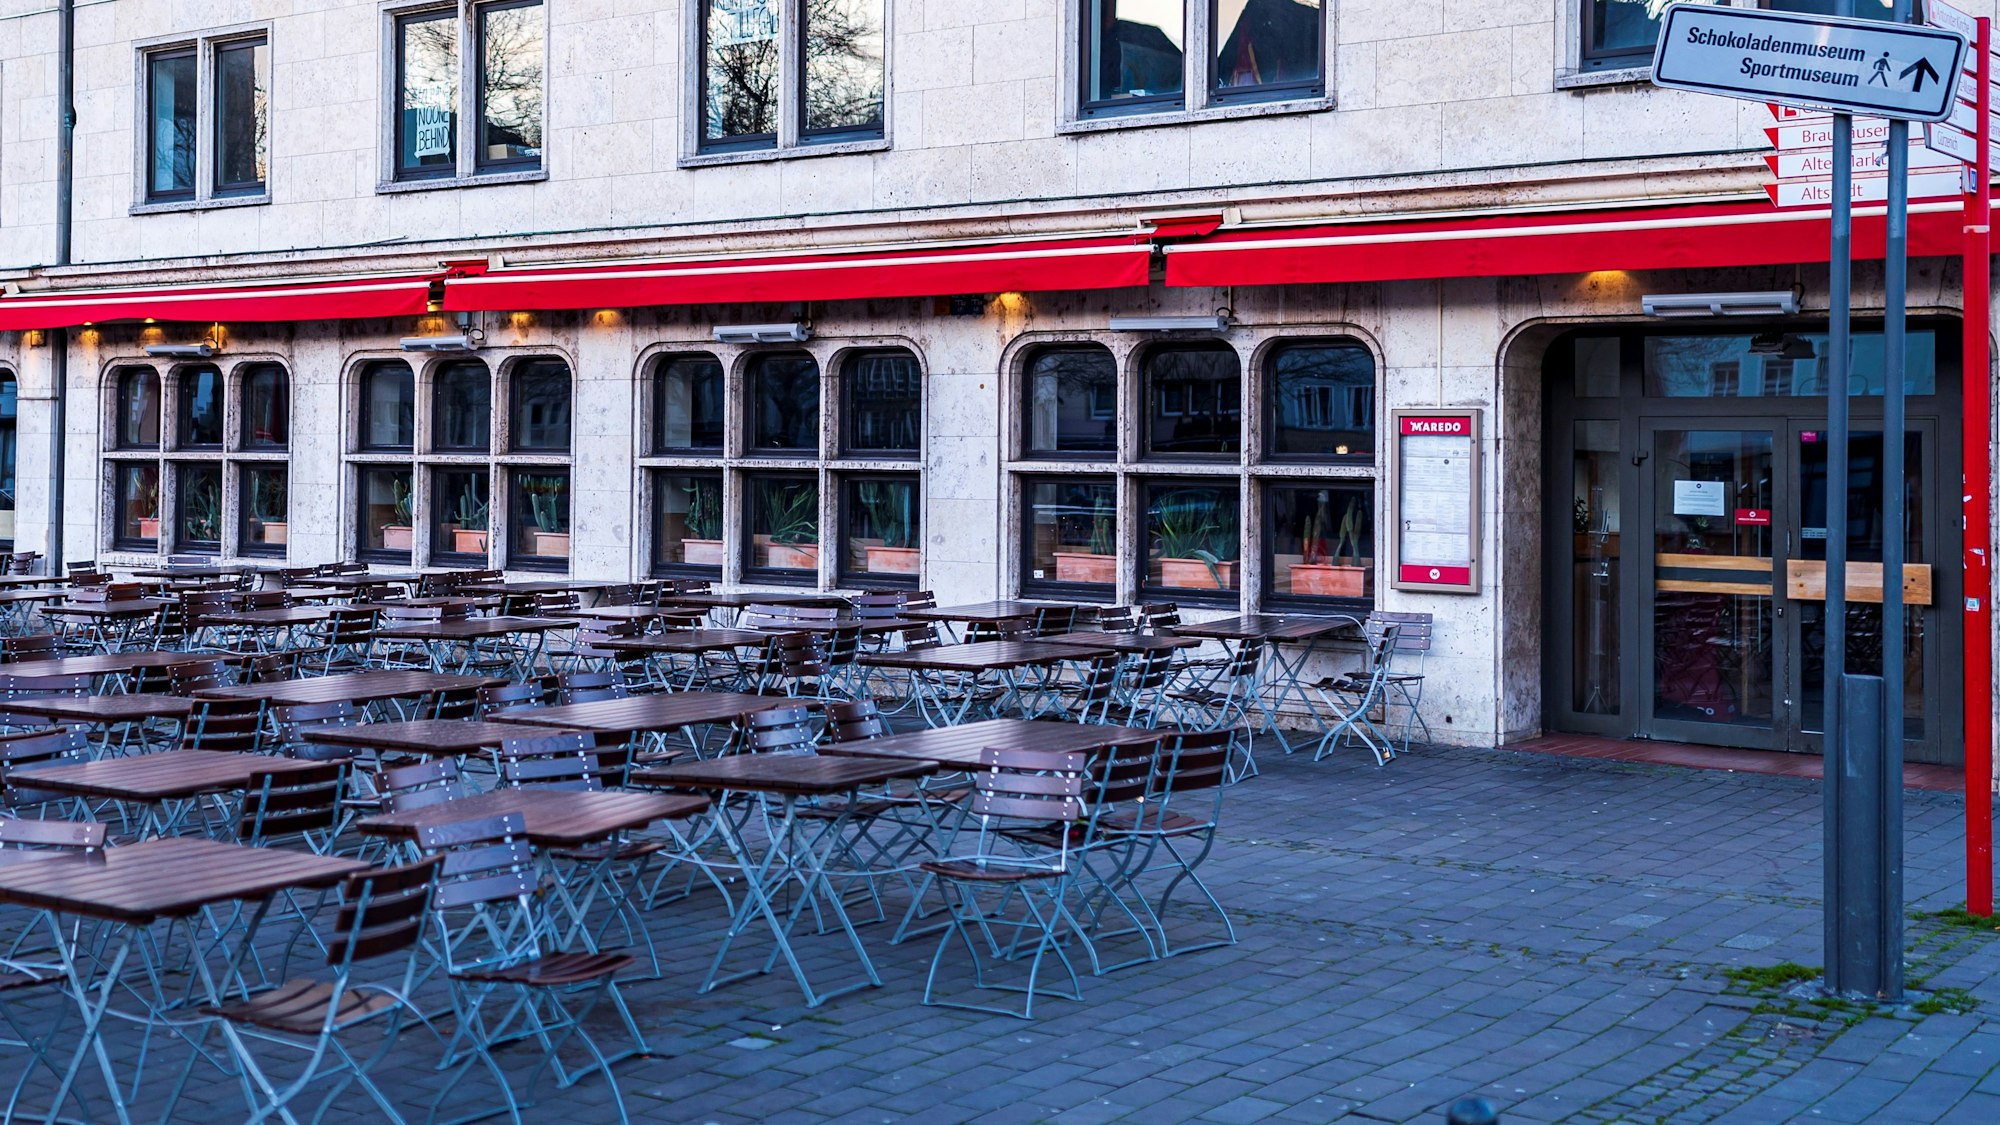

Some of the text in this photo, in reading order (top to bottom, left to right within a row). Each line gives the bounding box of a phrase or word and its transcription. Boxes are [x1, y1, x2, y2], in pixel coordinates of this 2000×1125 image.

[1687, 27, 1865, 62] Schokoladenmuseum
[1740, 57, 1859, 87] Sportmuseum
[418, 126, 449, 151] BEHIND
[1802, 126, 1889, 143] Brauäuser
[1851, 152, 1887, 167] arkt
[1801, 182, 1863, 200] Altsdt
[1409, 420, 1462, 433] MAREDO
